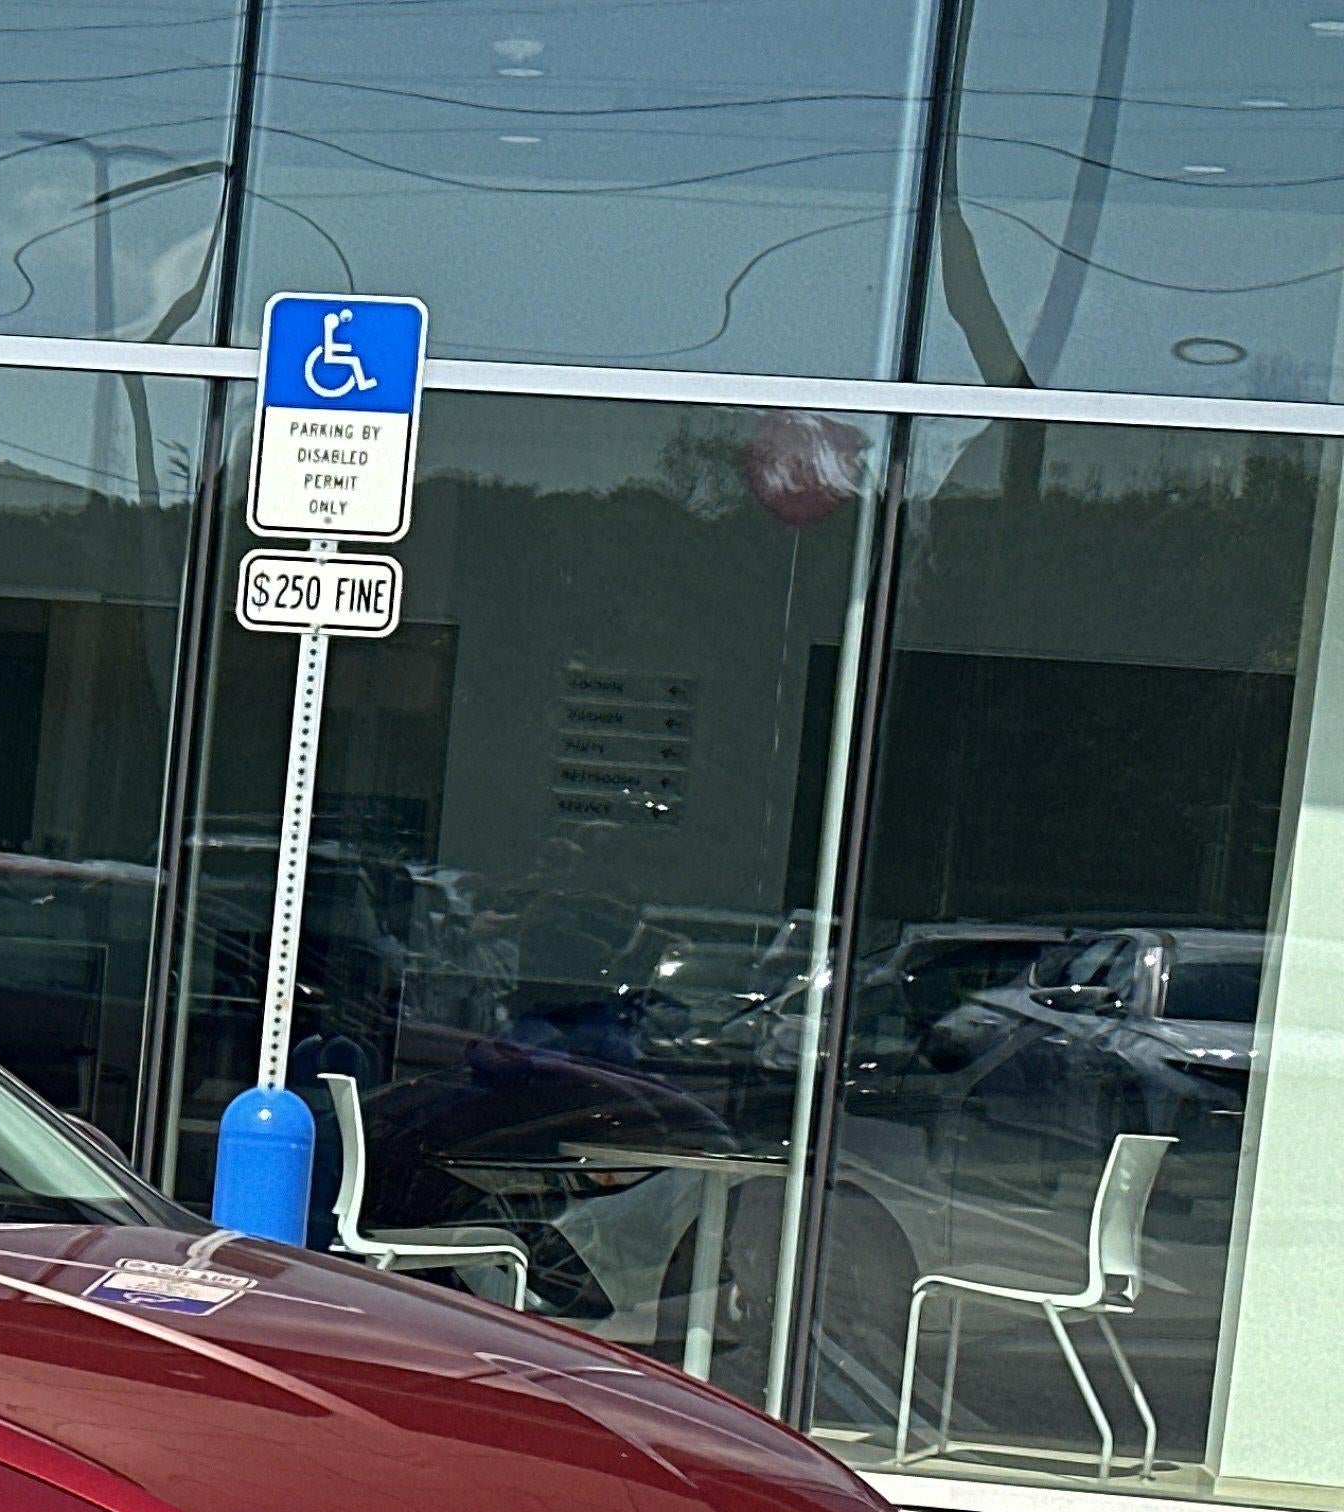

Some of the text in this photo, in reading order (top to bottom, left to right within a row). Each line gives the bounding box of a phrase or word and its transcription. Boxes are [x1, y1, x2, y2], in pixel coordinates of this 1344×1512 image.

[290, 422, 381, 441] PARKING BY
[297, 448, 368, 466] DISABLED
[304, 474, 358, 491] PERMIT
[309, 499, 348, 515] ONLY
[251, 570, 387, 614] $250 FINE
